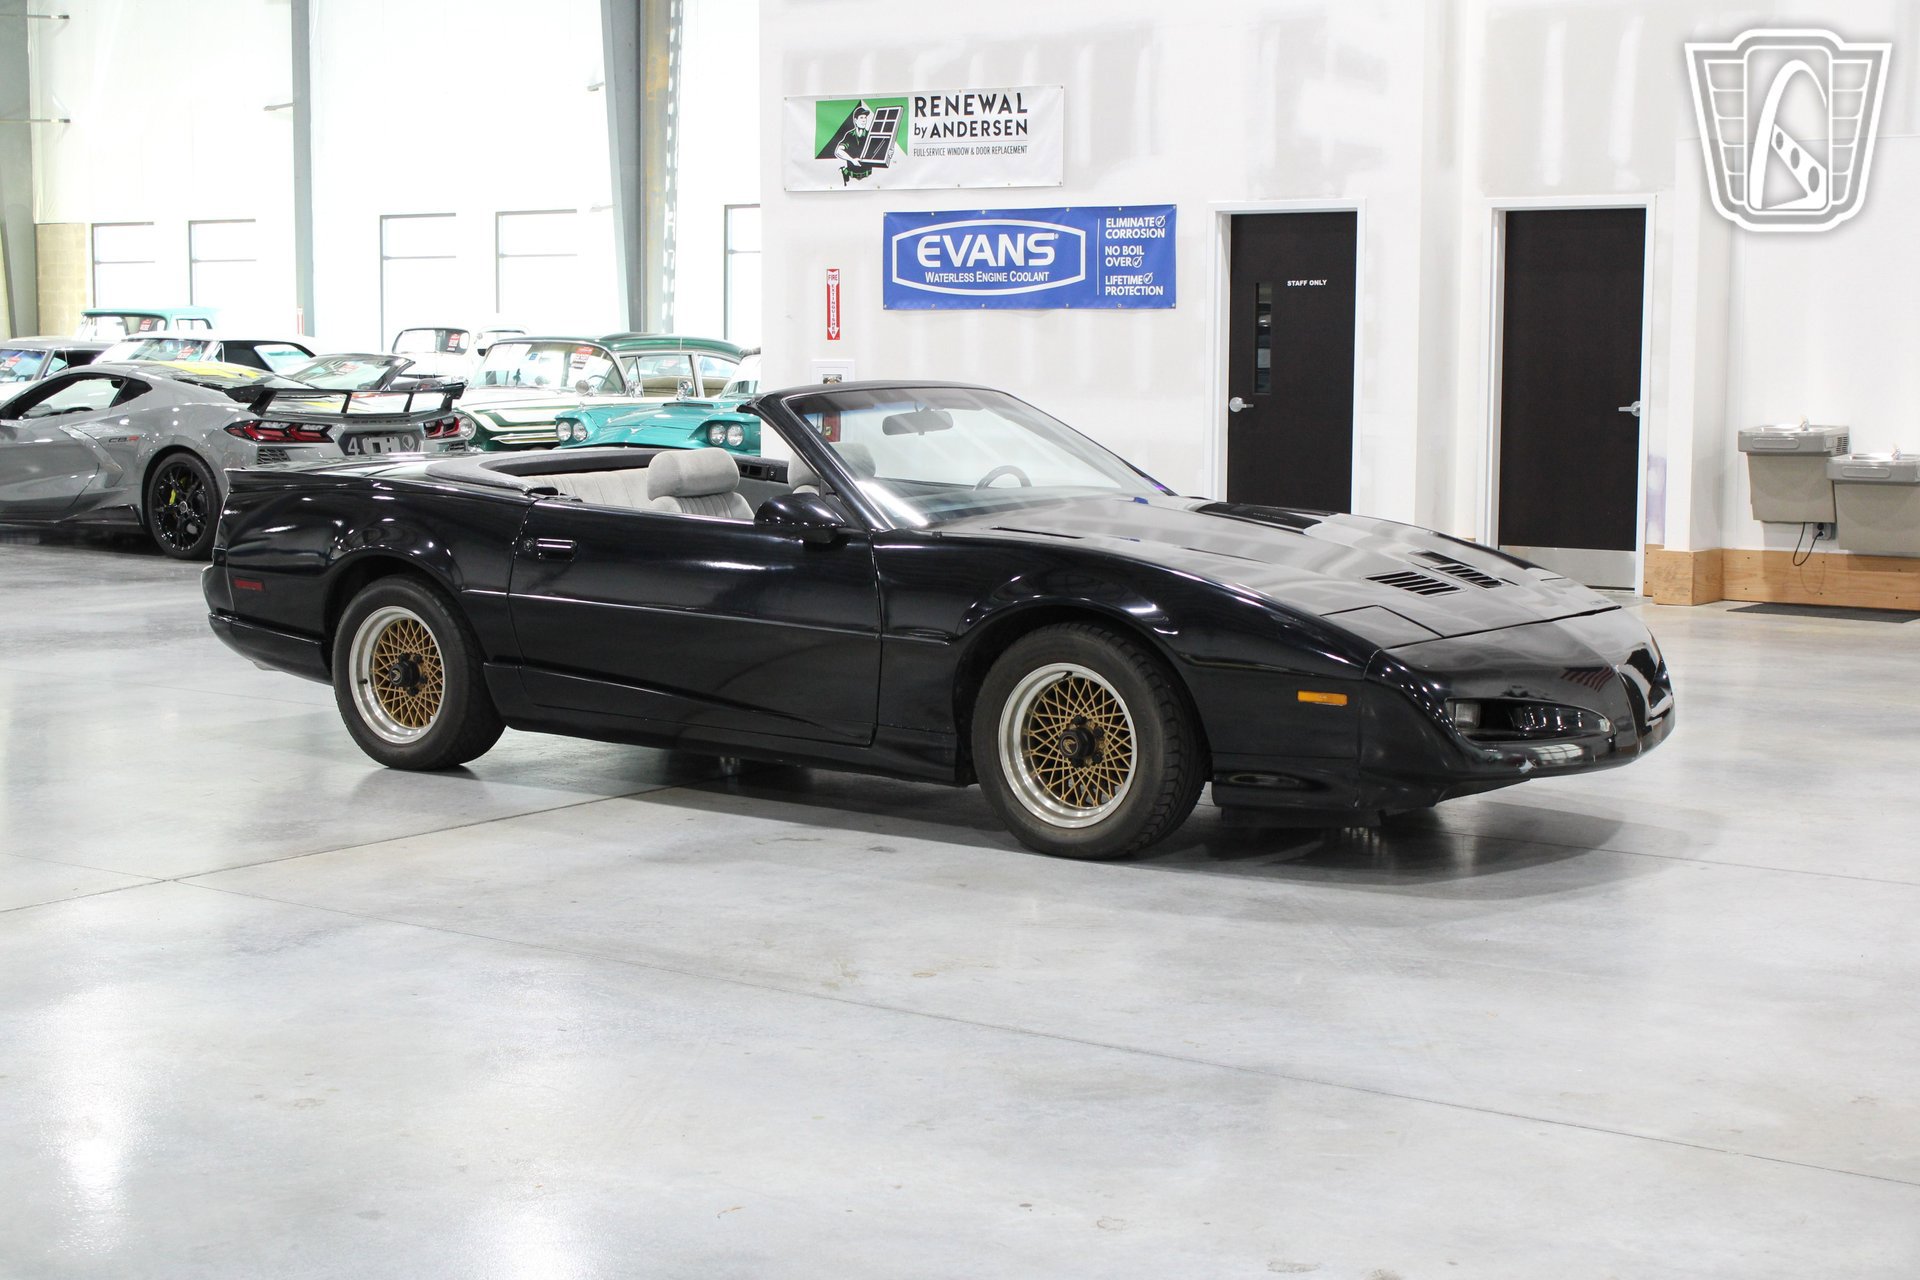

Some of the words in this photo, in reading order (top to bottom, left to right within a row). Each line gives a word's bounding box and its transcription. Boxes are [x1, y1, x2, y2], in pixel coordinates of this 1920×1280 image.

[914, 92, 1028, 118] RENEWAL
[914, 122, 928, 139] by
[930, 118, 1028, 138] ANDERSEN
[913, 147, 946, 157] FULL-SERVICE
[947, 146, 970, 156] WINDOW
[971, 146, 975, 156] &
[976, 146, 991, 155] DOOR
[992, 145, 1028, 155] REPLACEMENT
[1105, 216, 1155, 228] ELIMINATE
[1105, 228, 1165, 239] CORROSION
[917, 232, 1056, 268] EVANS
[1104, 245, 1120, 256] NO
[1122, 245, 1145, 256] BOIL
[1105, 256, 1132, 267] OVER
[925, 271, 975, 283] WATERLESS
[976, 271, 1008, 282] ENGINE
[1009, 270, 1050, 282] COOLANT
[1105, 274, 1144, 285] LIFETIME
[1105, 285, 1164, 296] PROTECTION
